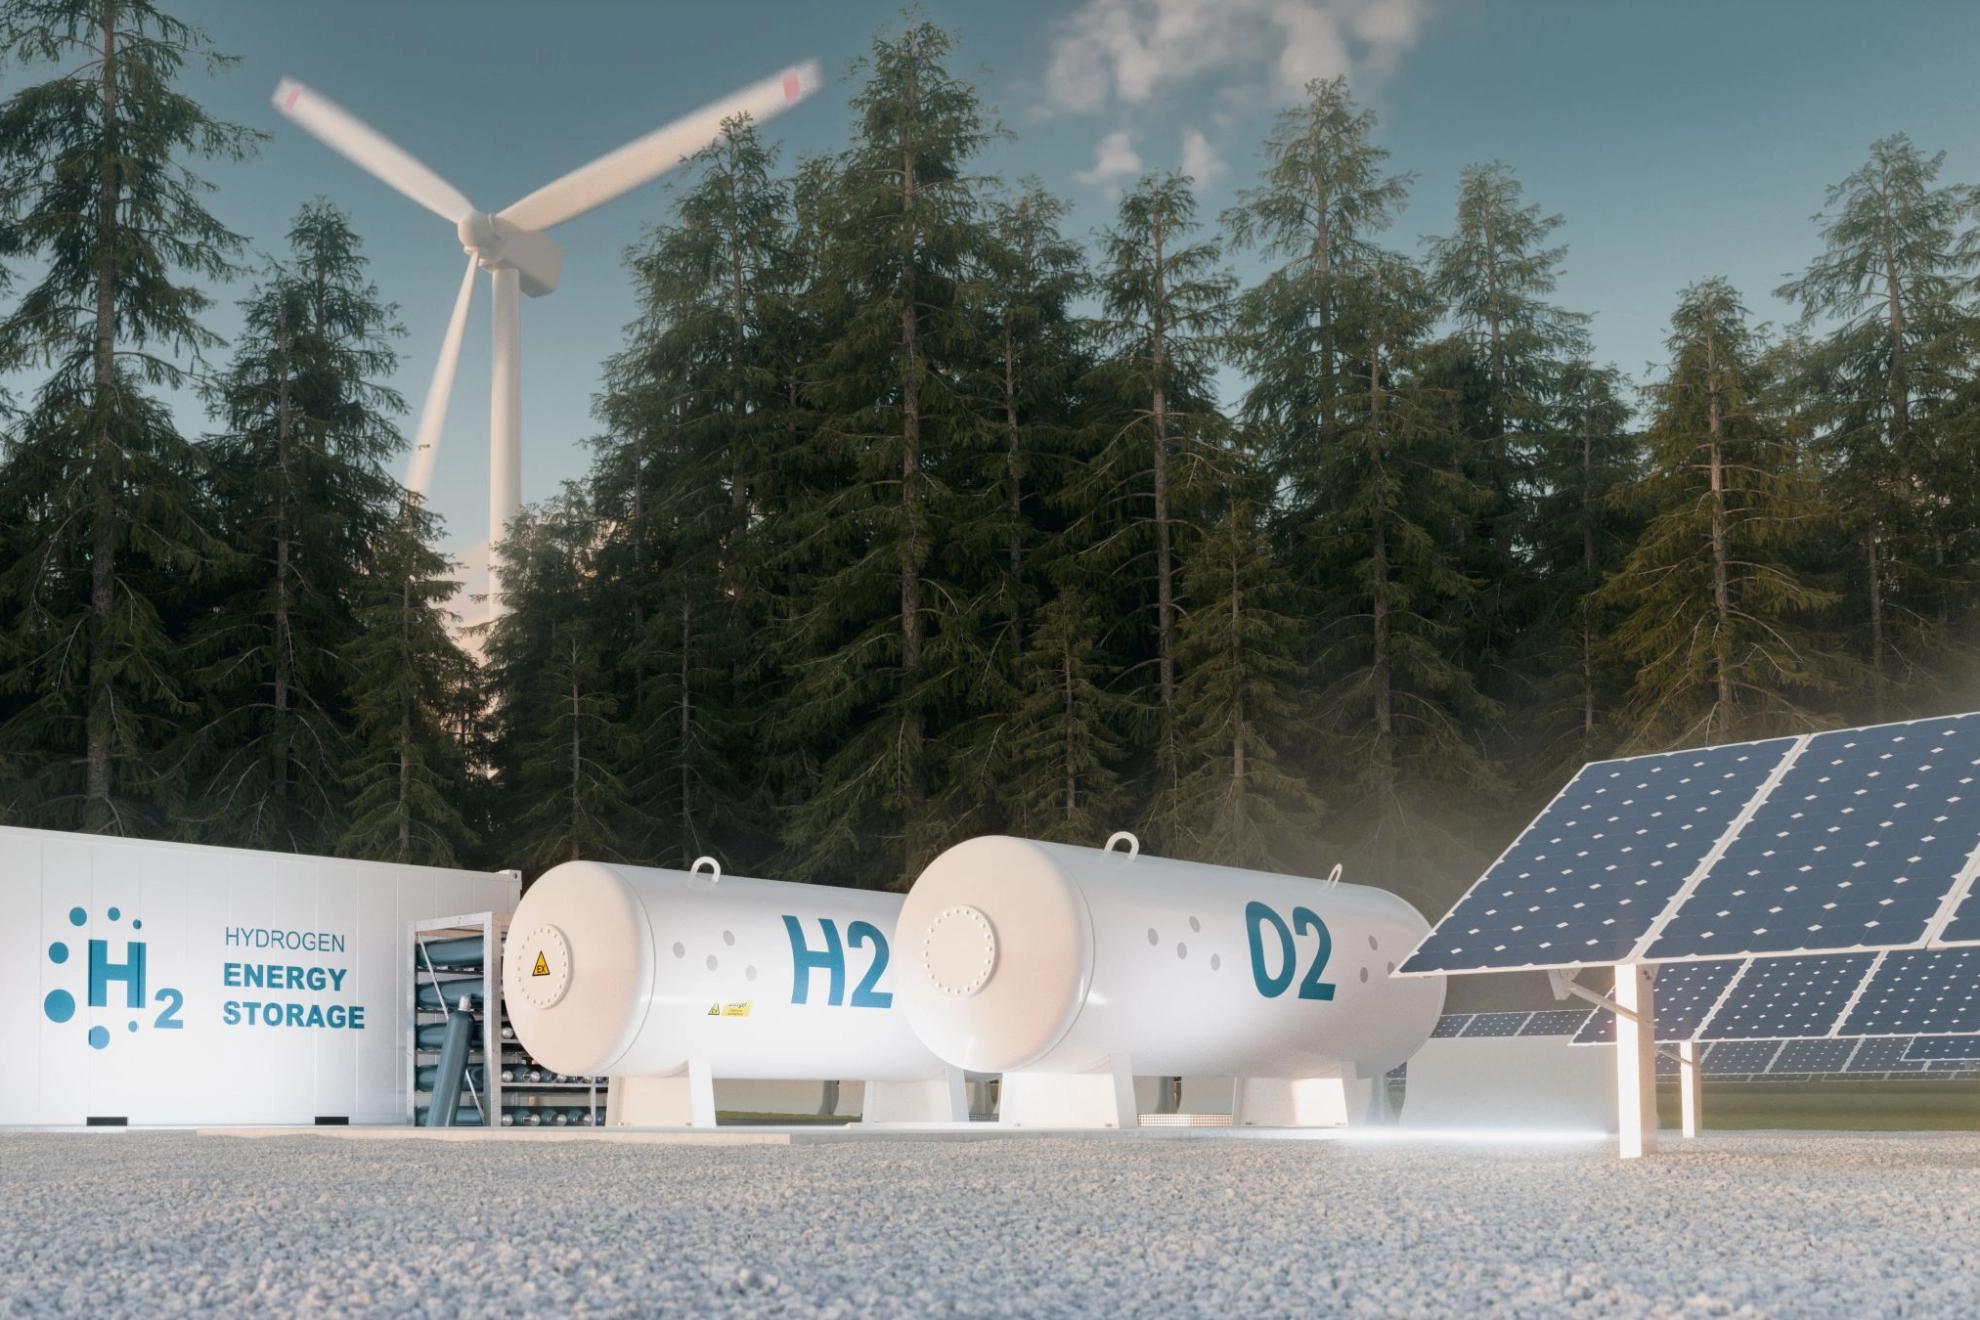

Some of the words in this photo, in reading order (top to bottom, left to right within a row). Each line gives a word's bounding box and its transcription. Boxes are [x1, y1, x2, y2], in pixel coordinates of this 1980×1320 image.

[225, 926, 345, 953] HYDROGEN
[223, 962, 347, 992] ENERGY
[536, 964, 546, 974] EX
[781, 914, 894, 1010] H2
[222, 1000, 366, 1030] STORAGE
